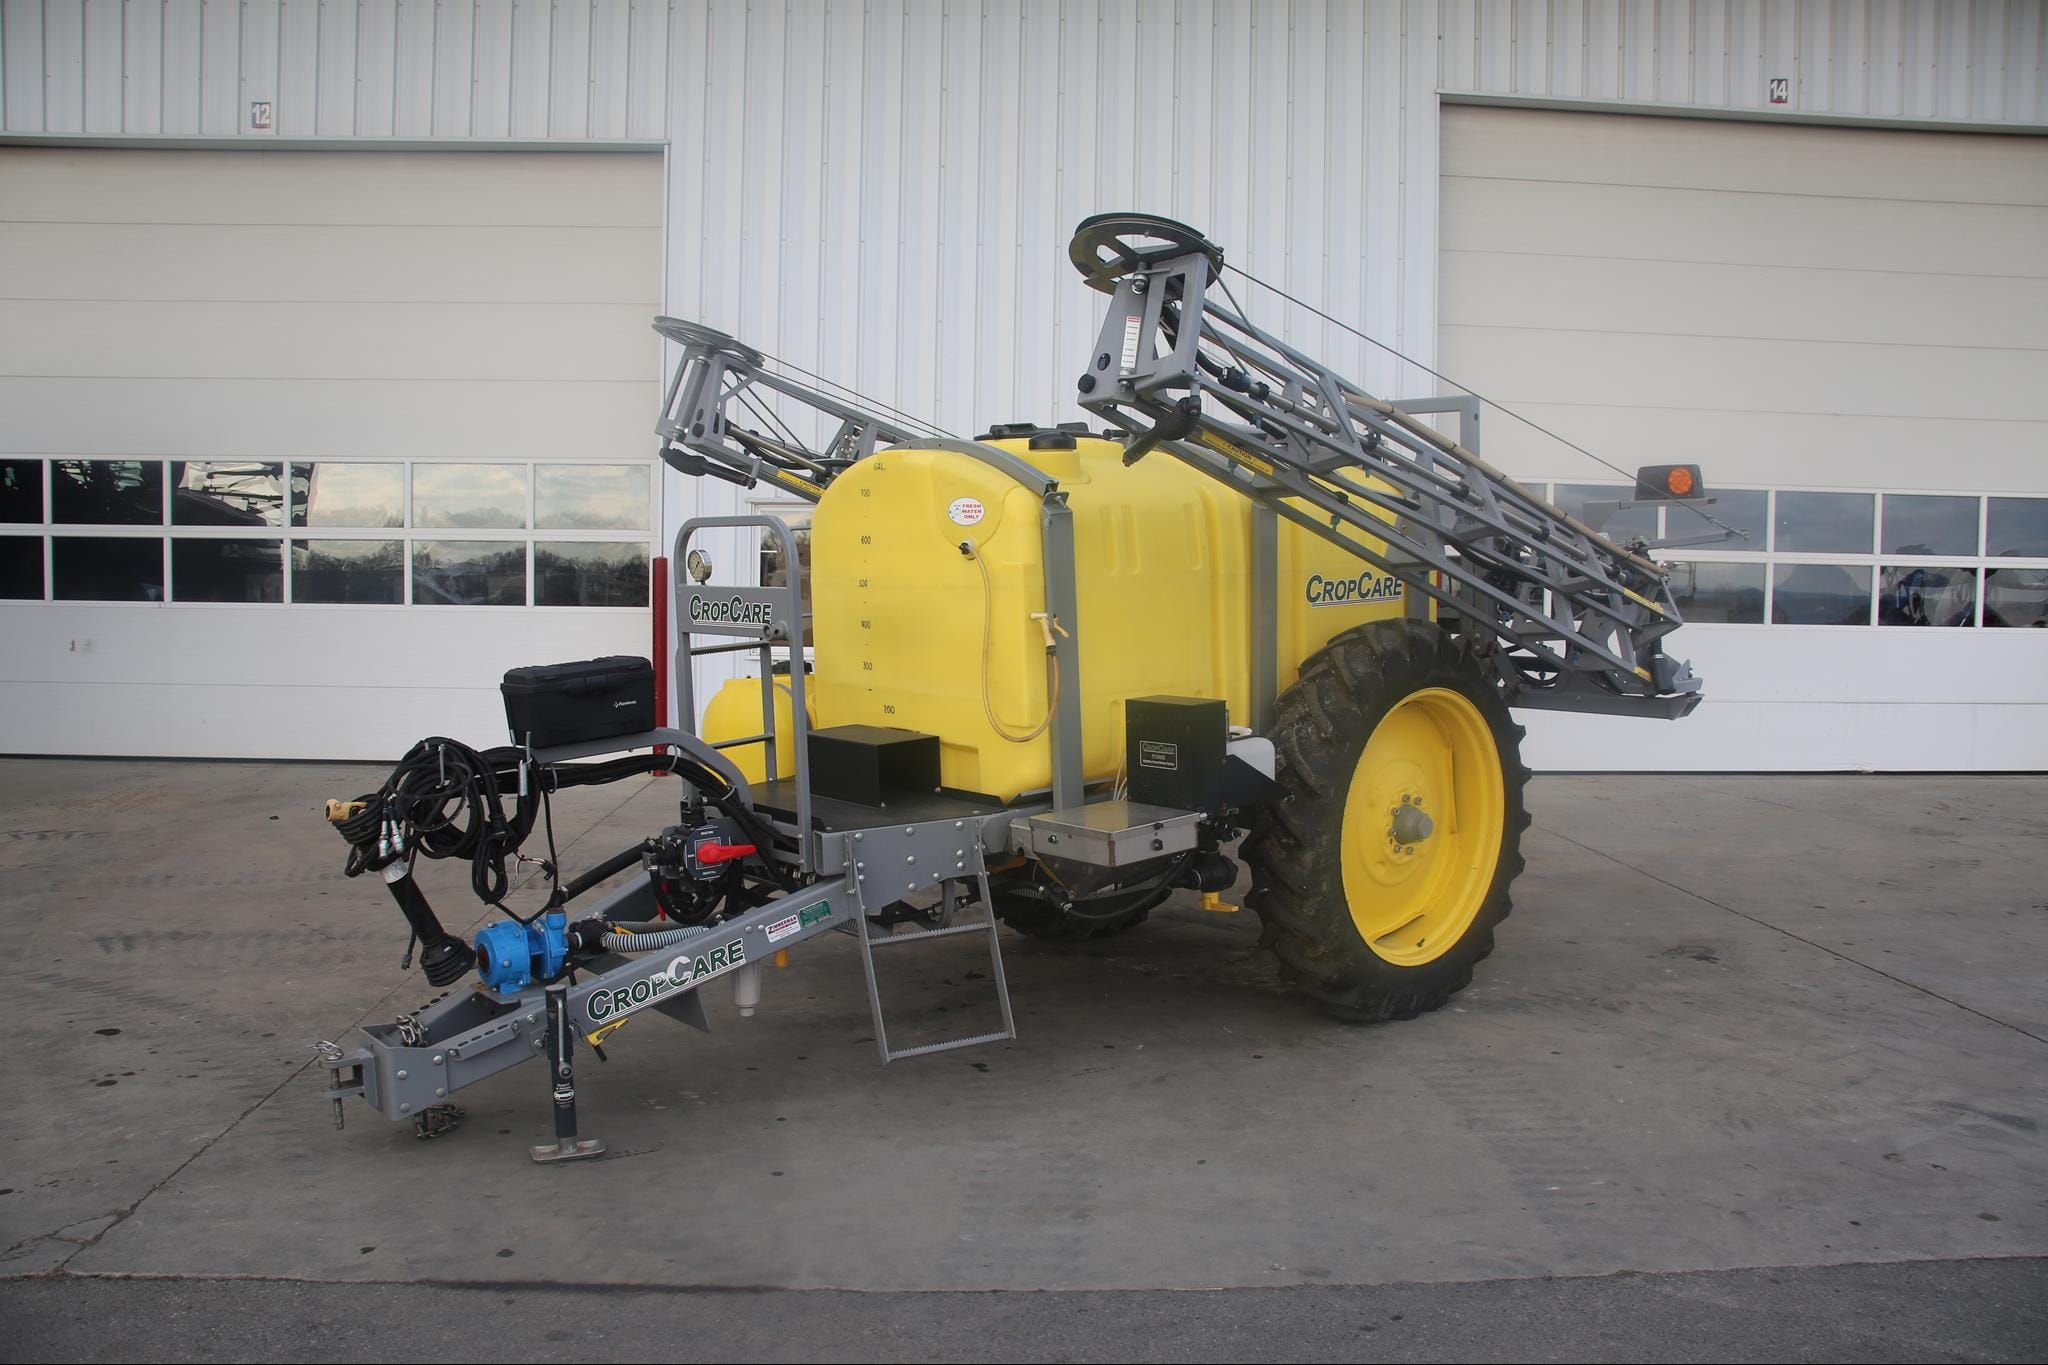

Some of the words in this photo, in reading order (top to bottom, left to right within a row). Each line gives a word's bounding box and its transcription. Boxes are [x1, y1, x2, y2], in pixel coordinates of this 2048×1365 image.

[1770, 80, 1787, 100] 14
[252, 103, 271, 124] 12
[860, 488, 871, 498] 700
[860, 535, 872, 545] 600
[860, 620, 871, 630] 400
[863, 661, 873, 671] 300
[883, 704, 896, 715] 200
